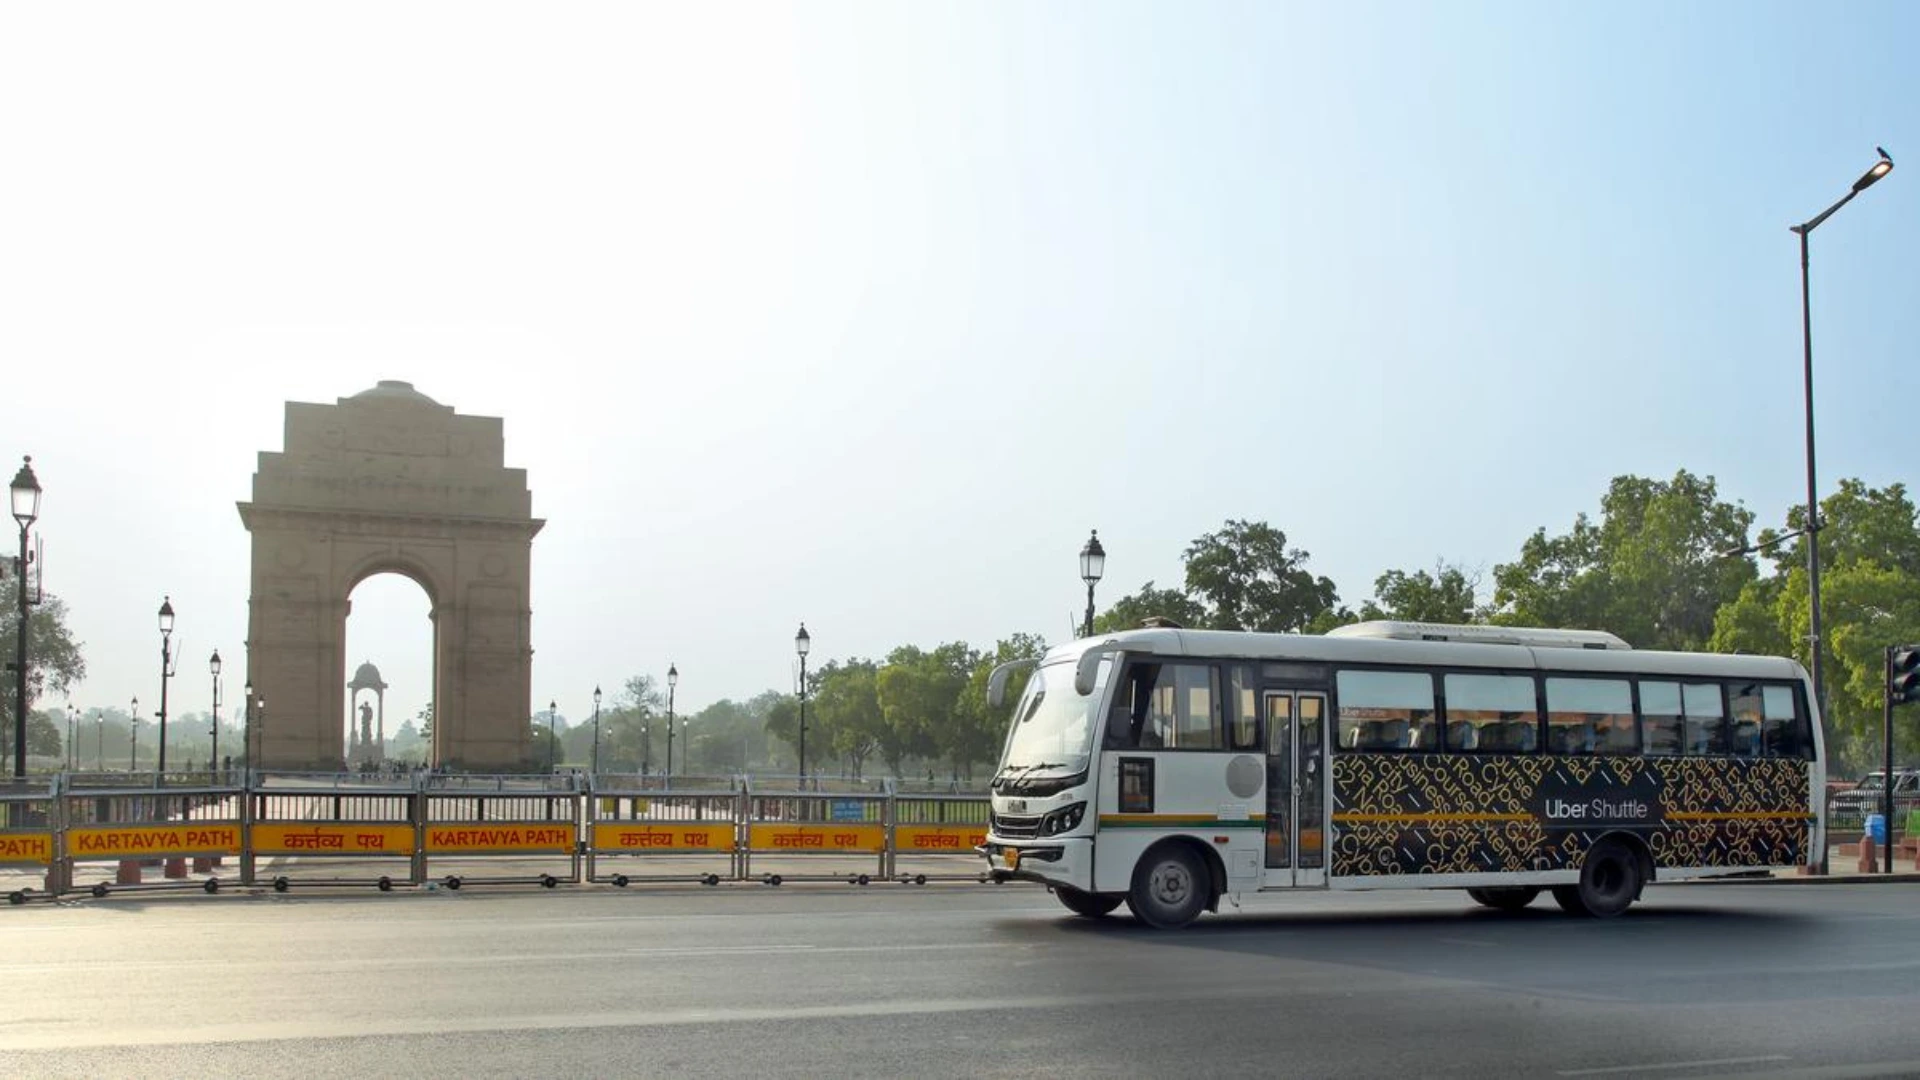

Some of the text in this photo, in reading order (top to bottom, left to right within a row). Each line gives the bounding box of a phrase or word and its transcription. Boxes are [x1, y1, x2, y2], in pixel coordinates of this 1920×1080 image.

[1453, 757, 1495, 808] Road
[1677, 757, 1715, 804] Road
[1545, 799, 1648, 818] Uber Shuttle
[79, 829, 234, 851] KARTAVYA PATH
[356, 834, 385, 849] पथ
[432, 829, 568, 846] KARTAVYA PATH
[683, 833, 709, 847] पथ
[833, 834, 858, 847] पथ
